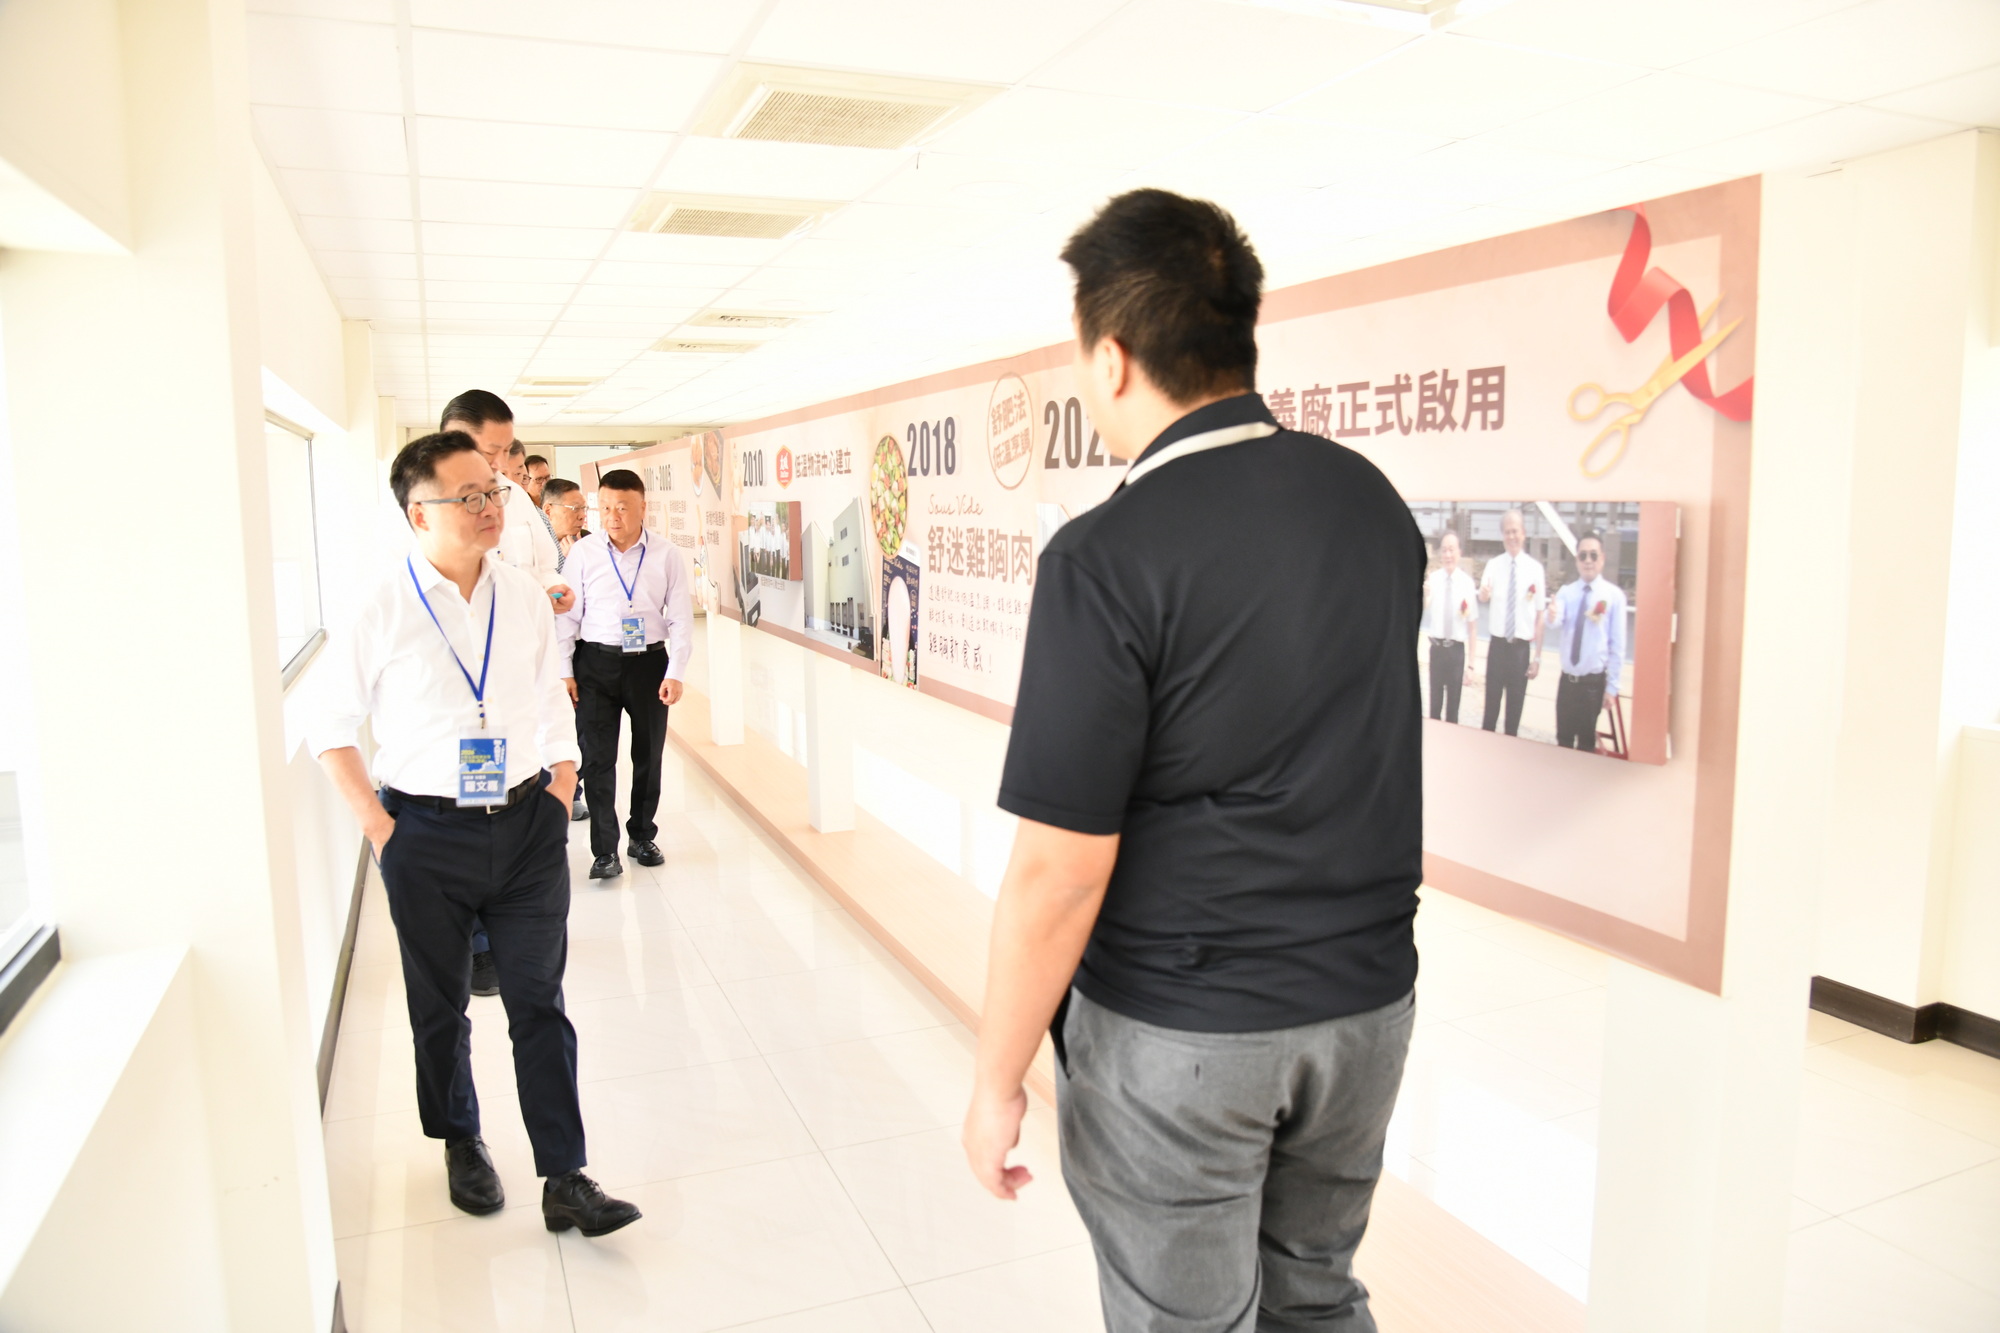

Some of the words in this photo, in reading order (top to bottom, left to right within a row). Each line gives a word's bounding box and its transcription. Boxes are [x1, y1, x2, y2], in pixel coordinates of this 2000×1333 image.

[991, 389, 1028, 437] 舒肥法
[1044, 396, 1128, 470] 202
[742, 449, 764, 487] 2010
[795, 447, 852, 478] 低溫物流中心建立
[907, 416, 956, 477] 2018
[928, 493, 956, 516] Sous
[956, 494, 984, 516] Vide
[927, 525, 1034, 586] 舒迷雞胸肉
